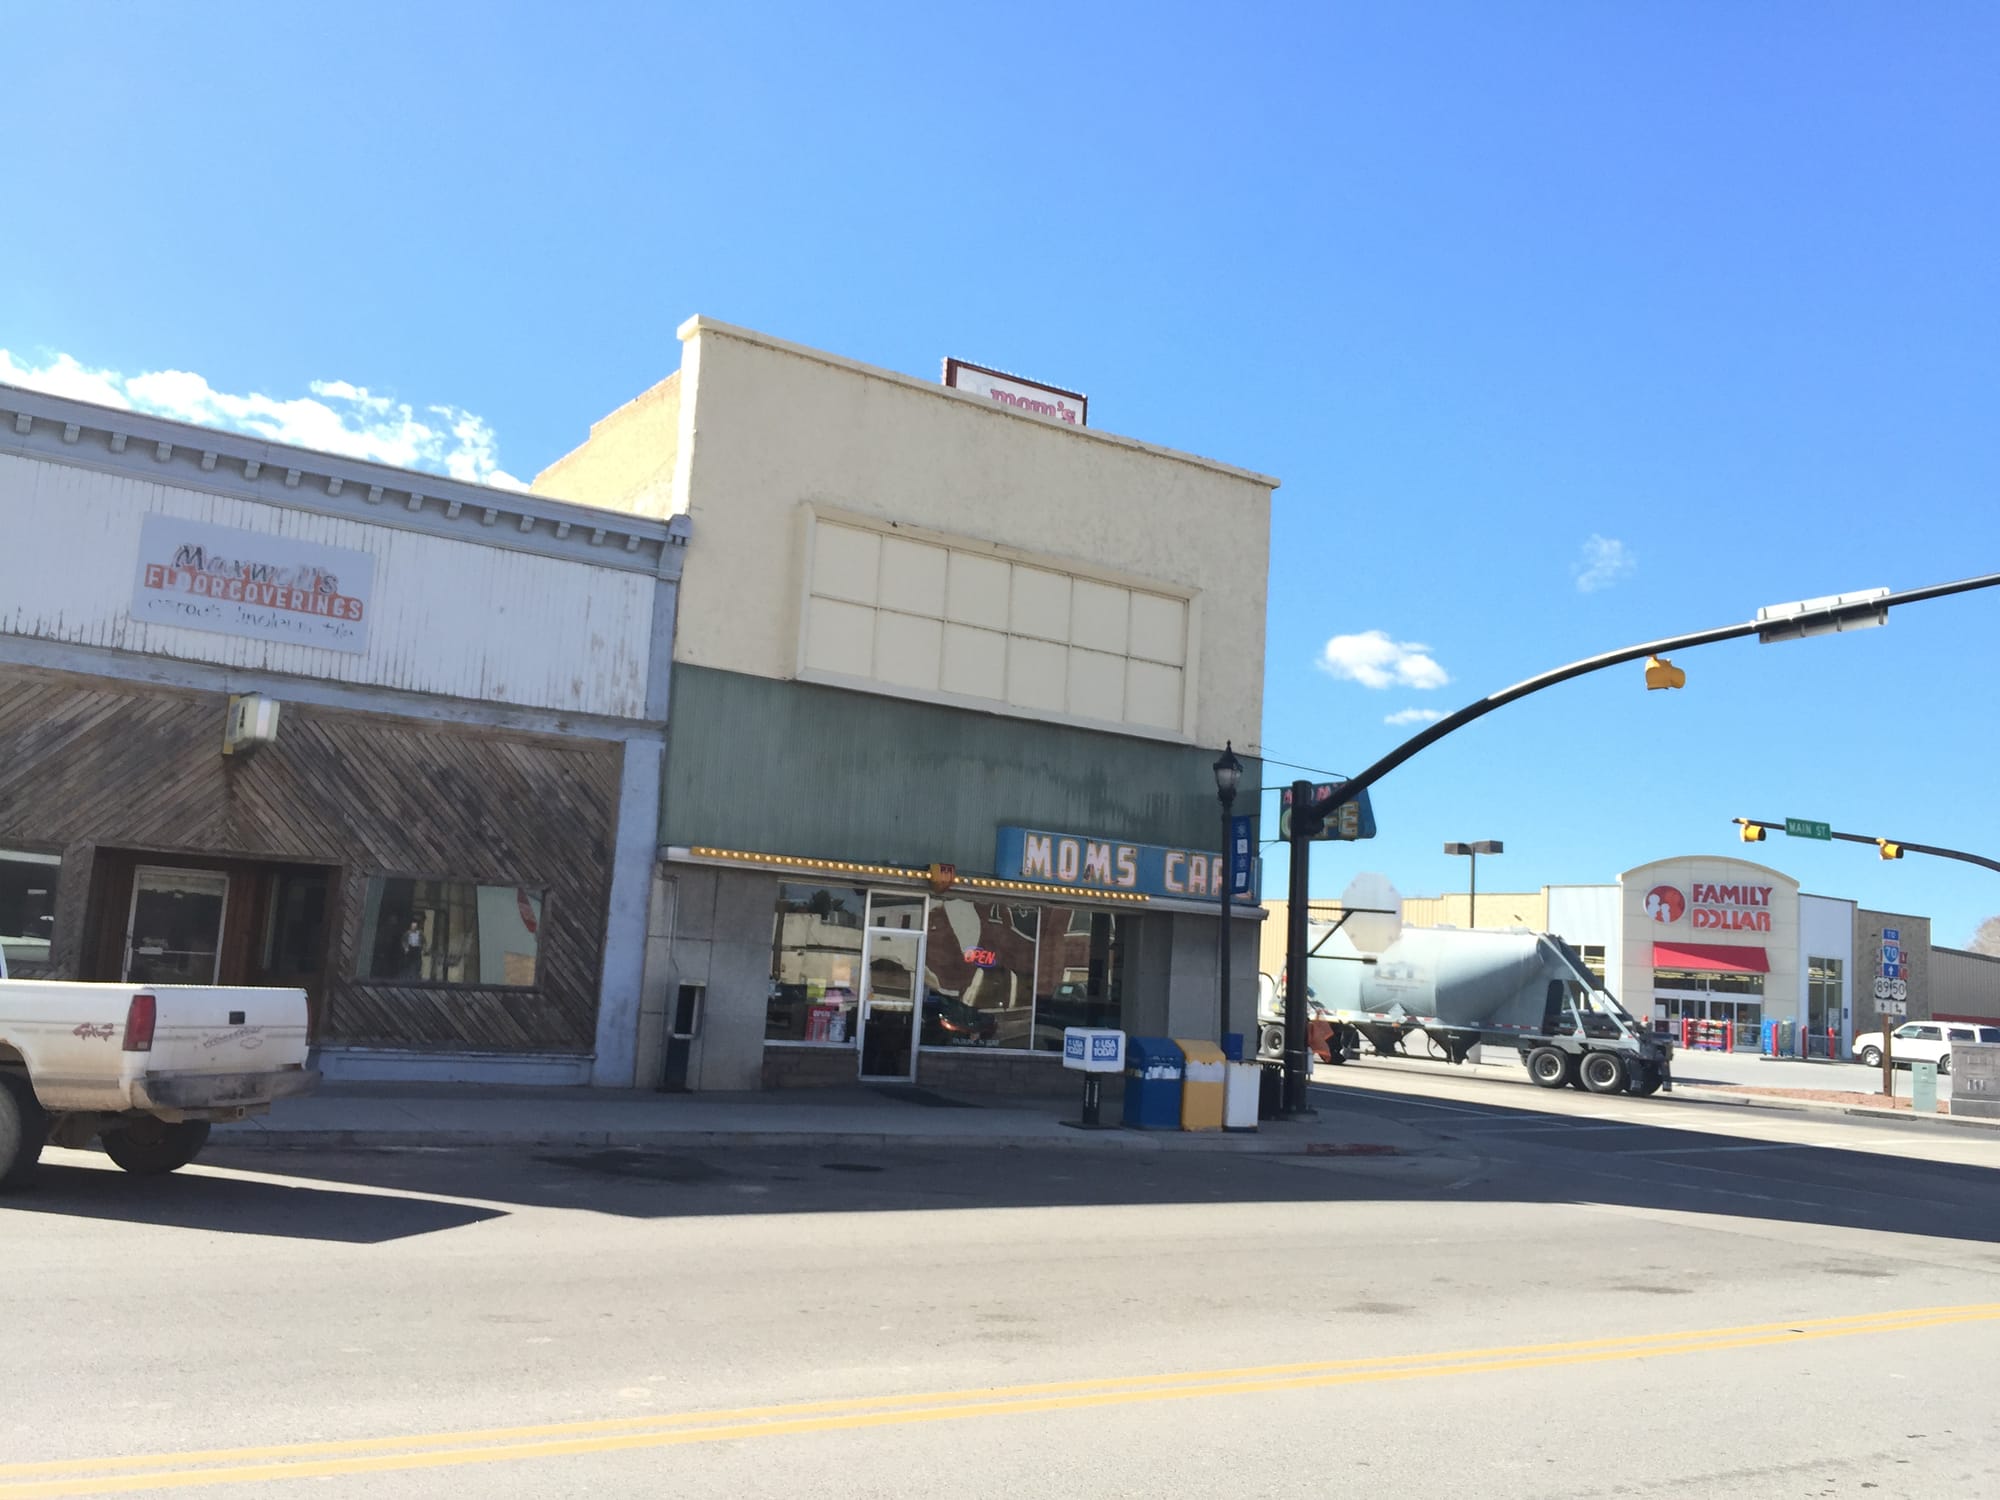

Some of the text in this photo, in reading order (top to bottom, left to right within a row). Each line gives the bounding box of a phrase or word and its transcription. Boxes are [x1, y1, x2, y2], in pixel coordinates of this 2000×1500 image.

[1789, 822, 1826, 836] MAIN ST
[1023, 834, 1136, 888] MOMS
[1693, 883, 1773, 906] FAMILY
[1693, 908, 1772, 932] DOLLAR
[964, 948, 996, 965] OPEN
[1885, 946, 1898, 958] 70
[1876, 980, 1889, 994] 89
[1892, 982, 1905, 996] 50
[1101, 1039, 1116, 1048] USA
[1094, 1047, 1117, 1057] TODAY
